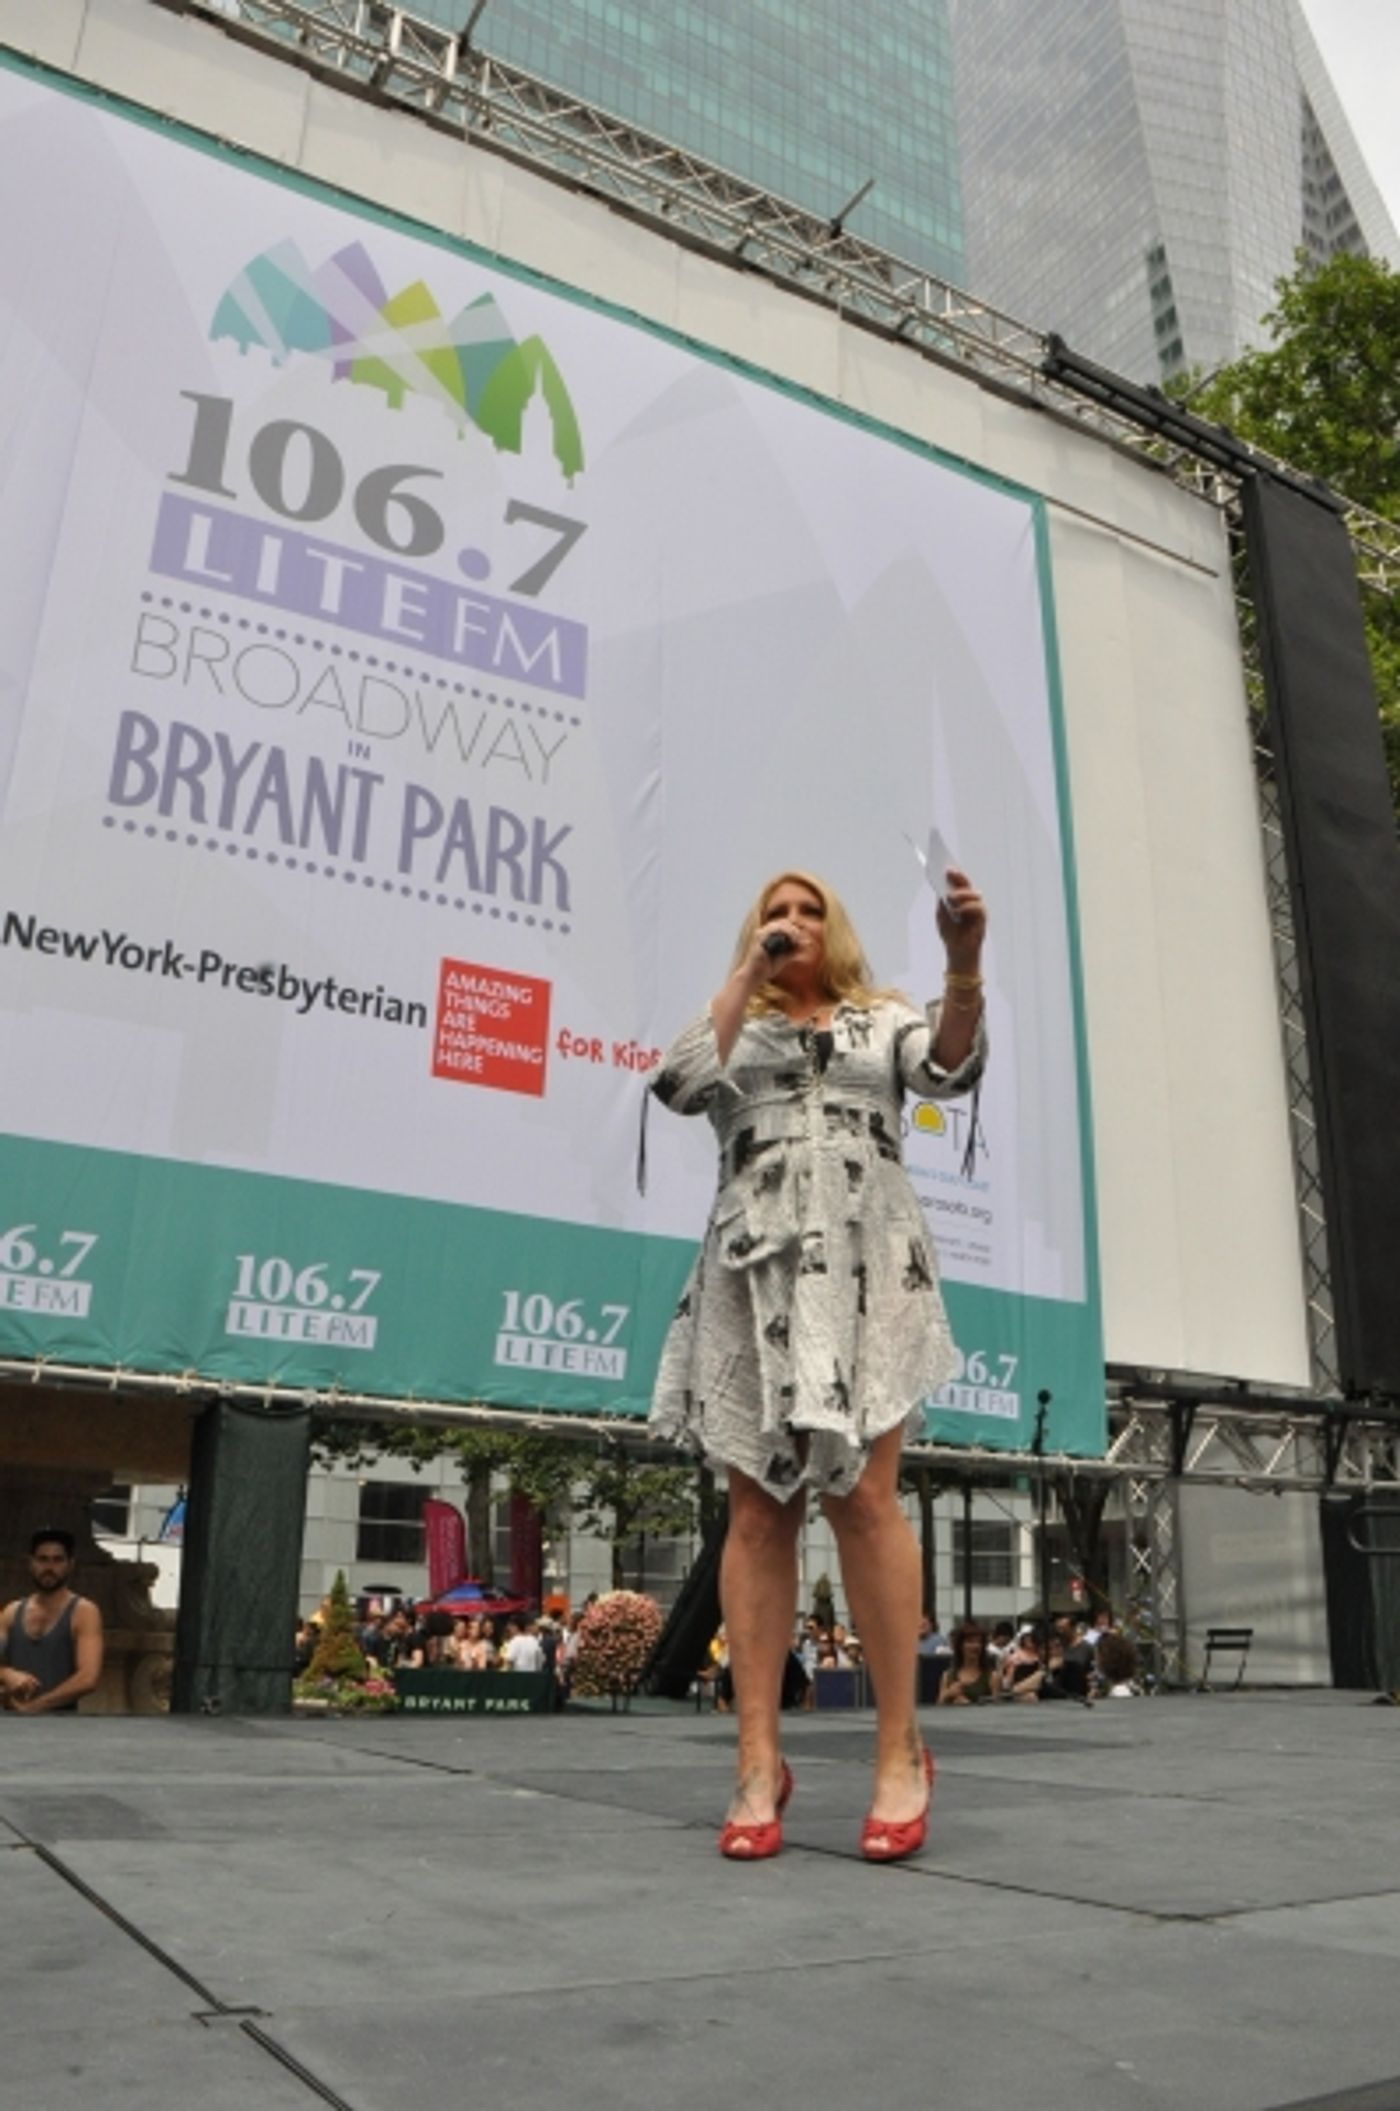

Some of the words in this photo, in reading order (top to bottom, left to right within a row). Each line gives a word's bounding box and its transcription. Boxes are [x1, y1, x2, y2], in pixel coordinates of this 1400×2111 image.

[165, 389, 589, 598] 106.7
[130, 611, 568, 785] BROADWAY
[347, 739, 371, 761] IN
[107, 709, 385, 864] BRYANT
[397, 781, 574, 913] PARK
[445, 970, 534, 1005] AMAZING
[441, 1009, 477, 1032] ARE
[443, 990, 512, 1022] THINGS
[435, 1048, 485, 1075] HERE
[438, 1028, 544, 1066] HAPPENING
[231, 1254, 383, 1311] 106.7
[500, 1290, 630, 1345] 106.7
[403, 1695, 477, 1711] BRYANT
[484, 1698, 530, 1712] PARK
